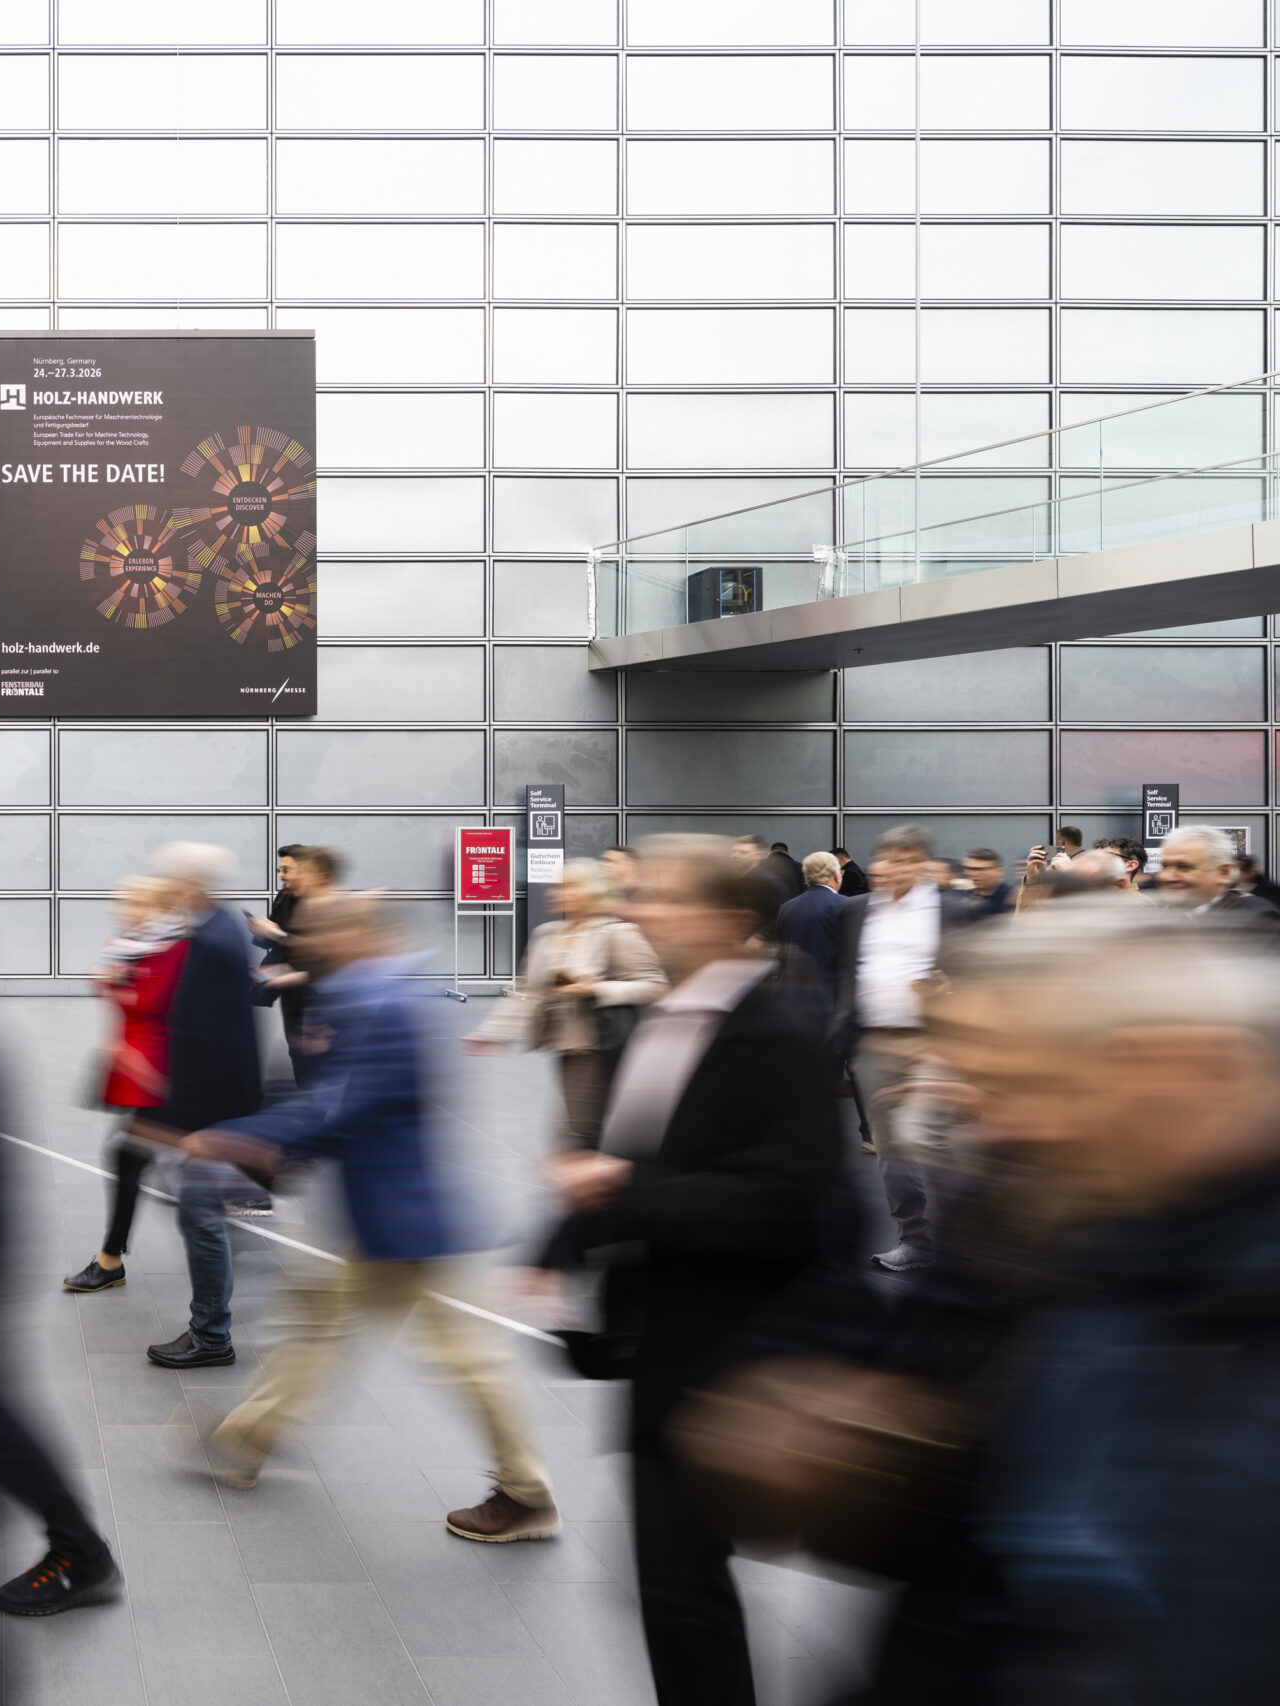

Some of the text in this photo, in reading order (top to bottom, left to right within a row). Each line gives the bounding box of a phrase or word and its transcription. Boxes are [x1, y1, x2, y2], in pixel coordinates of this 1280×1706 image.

[33, 358, 96, 366] Nürnberg, Germany
[34, 391, 163, 404] HOLZ-HANDWERK
[2, 464, 164, 483] SAVE THE DATE!
[2, 642, 99, 653] holz-handwerk.de
[1, 688, 44, 696] FRONTALE
